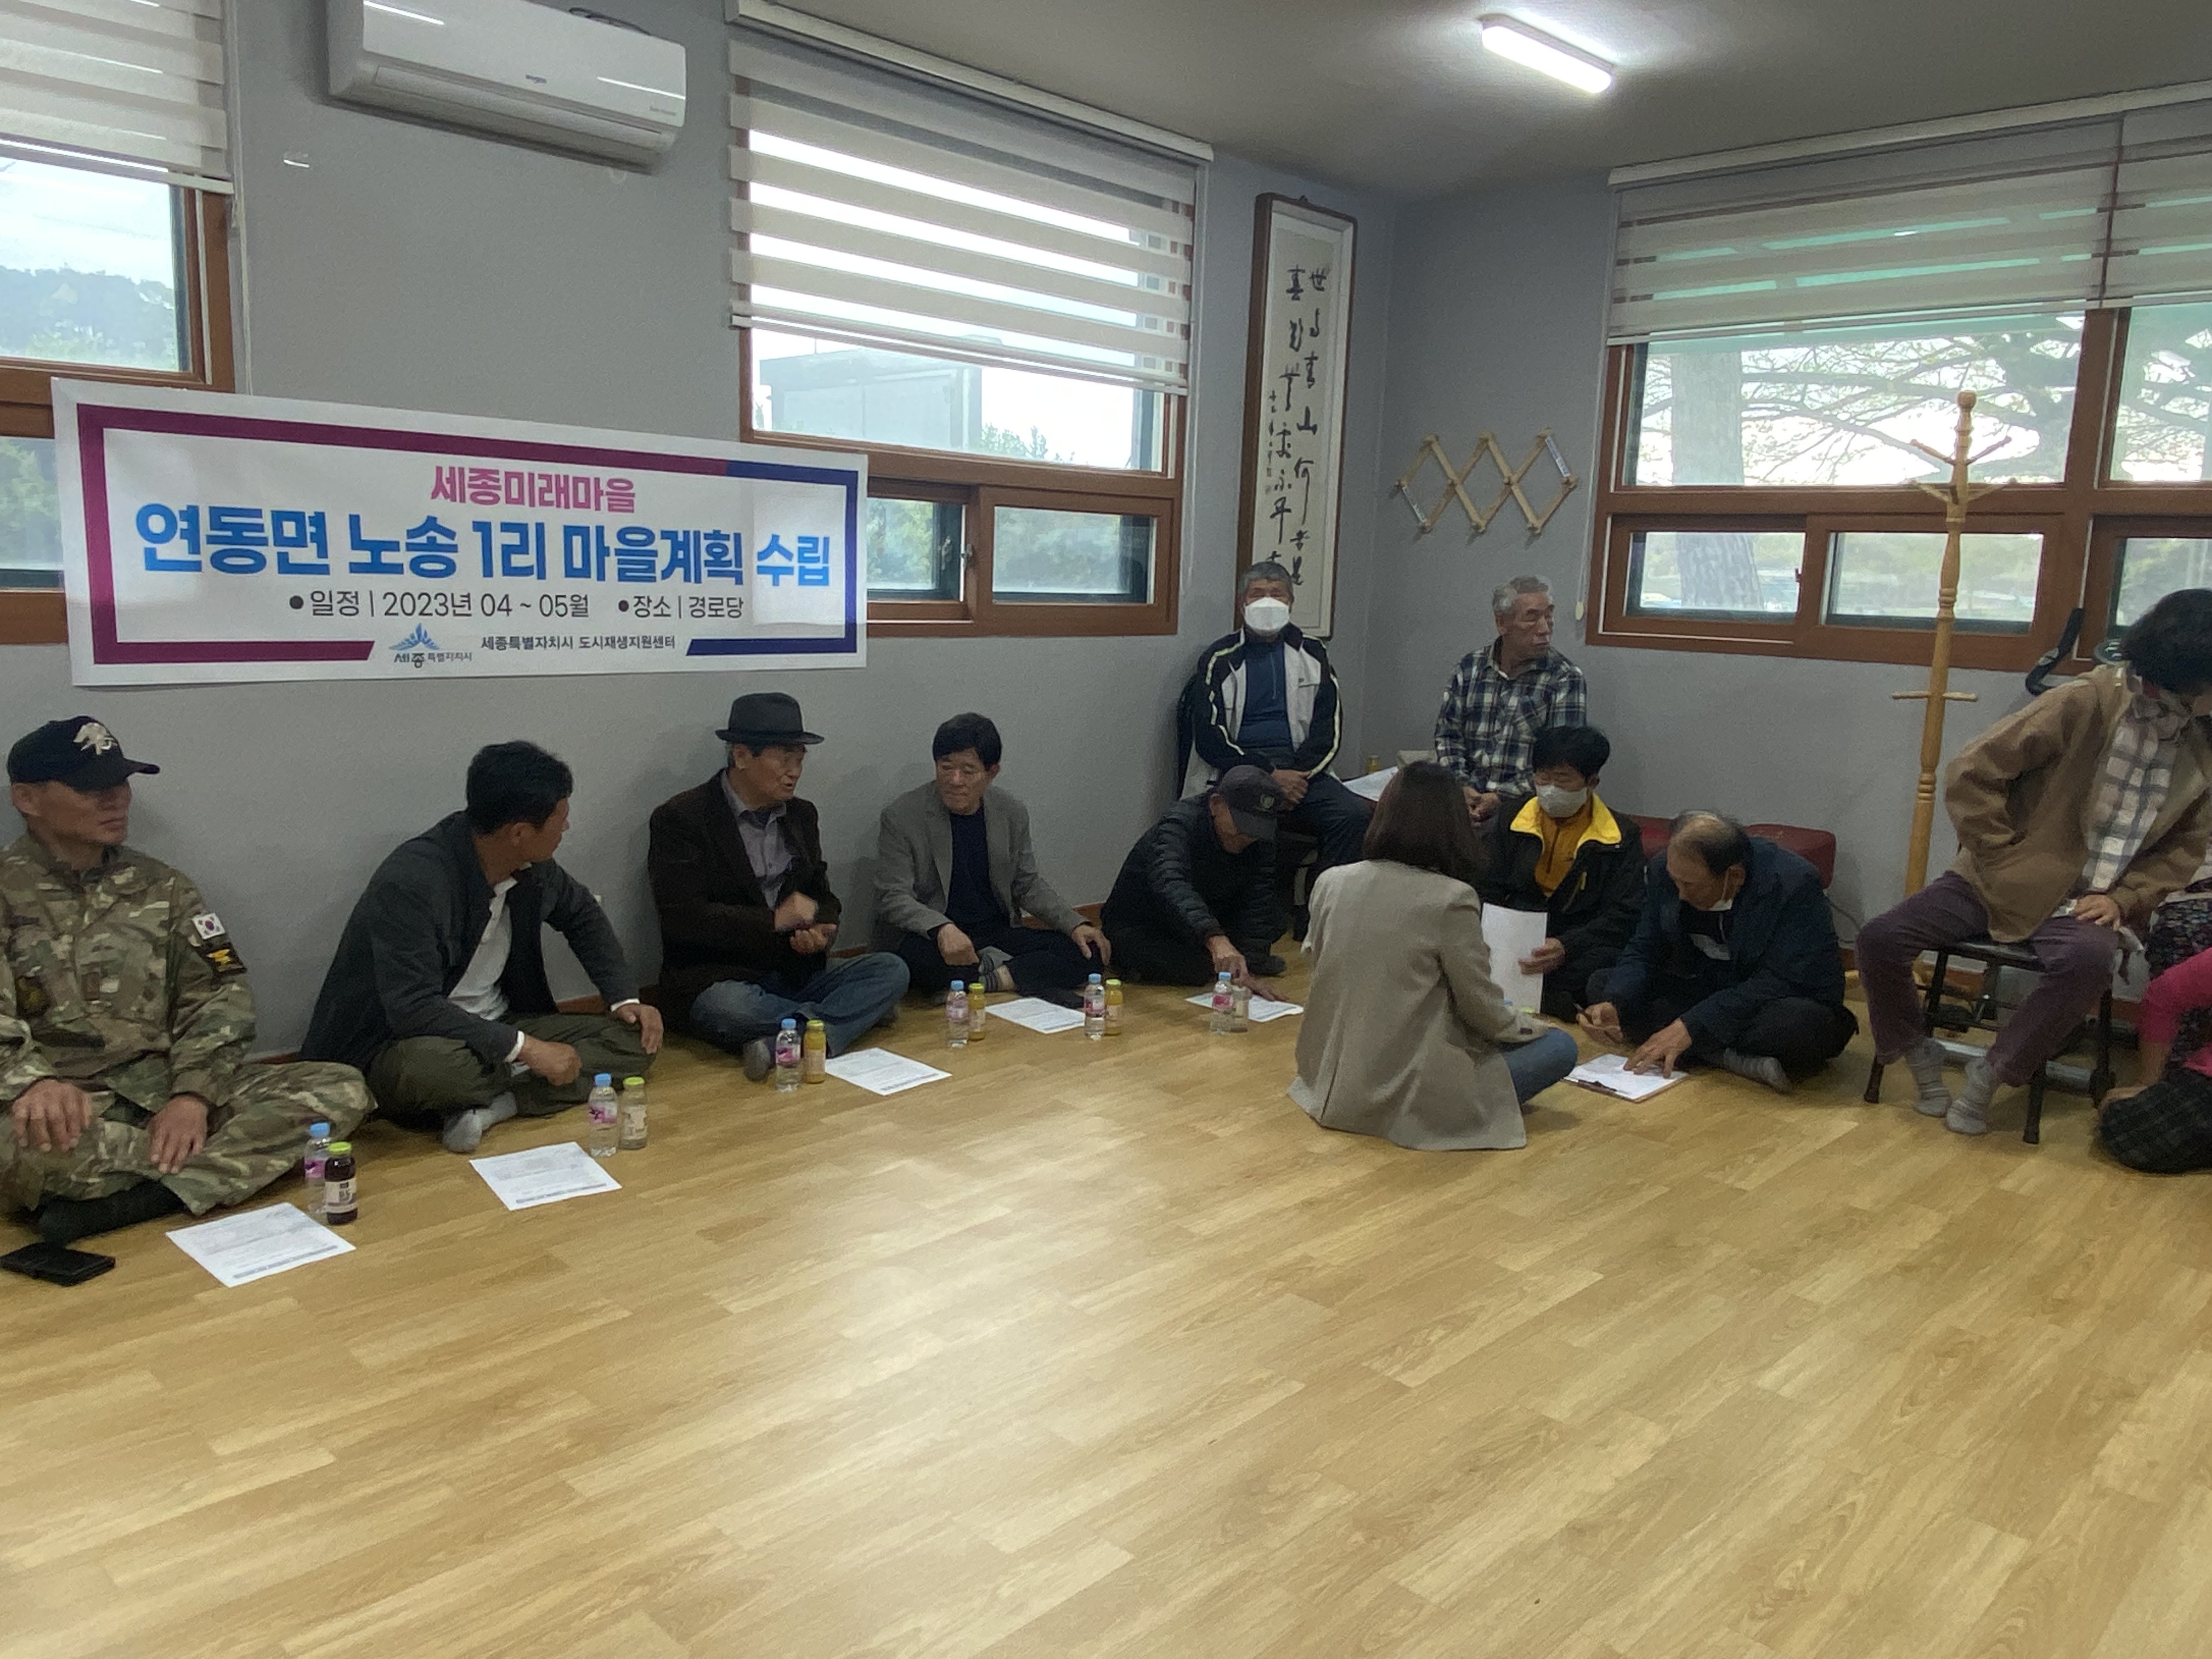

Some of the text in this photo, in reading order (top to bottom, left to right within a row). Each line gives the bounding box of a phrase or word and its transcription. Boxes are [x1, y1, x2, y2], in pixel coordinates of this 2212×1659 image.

[431, 465, 636, 514] 세종미래마을
[136, 503, 831, 587] 연동면 노송 1리 마을계획 수립
[309, 590, 360, 617] 일정
[383, 591, 473, 617] 2023년
[481, 593, 512, 617] 04
[539, 594, 590, 618] 05월
[633, 595, 673, 619] 장소
[689, 596, 744, 619] 경로당
[481, 635, 676, 651] 세종특별자치시 도시재생지원센터
[393, 652, 473, 668] 세종 특별자치시
